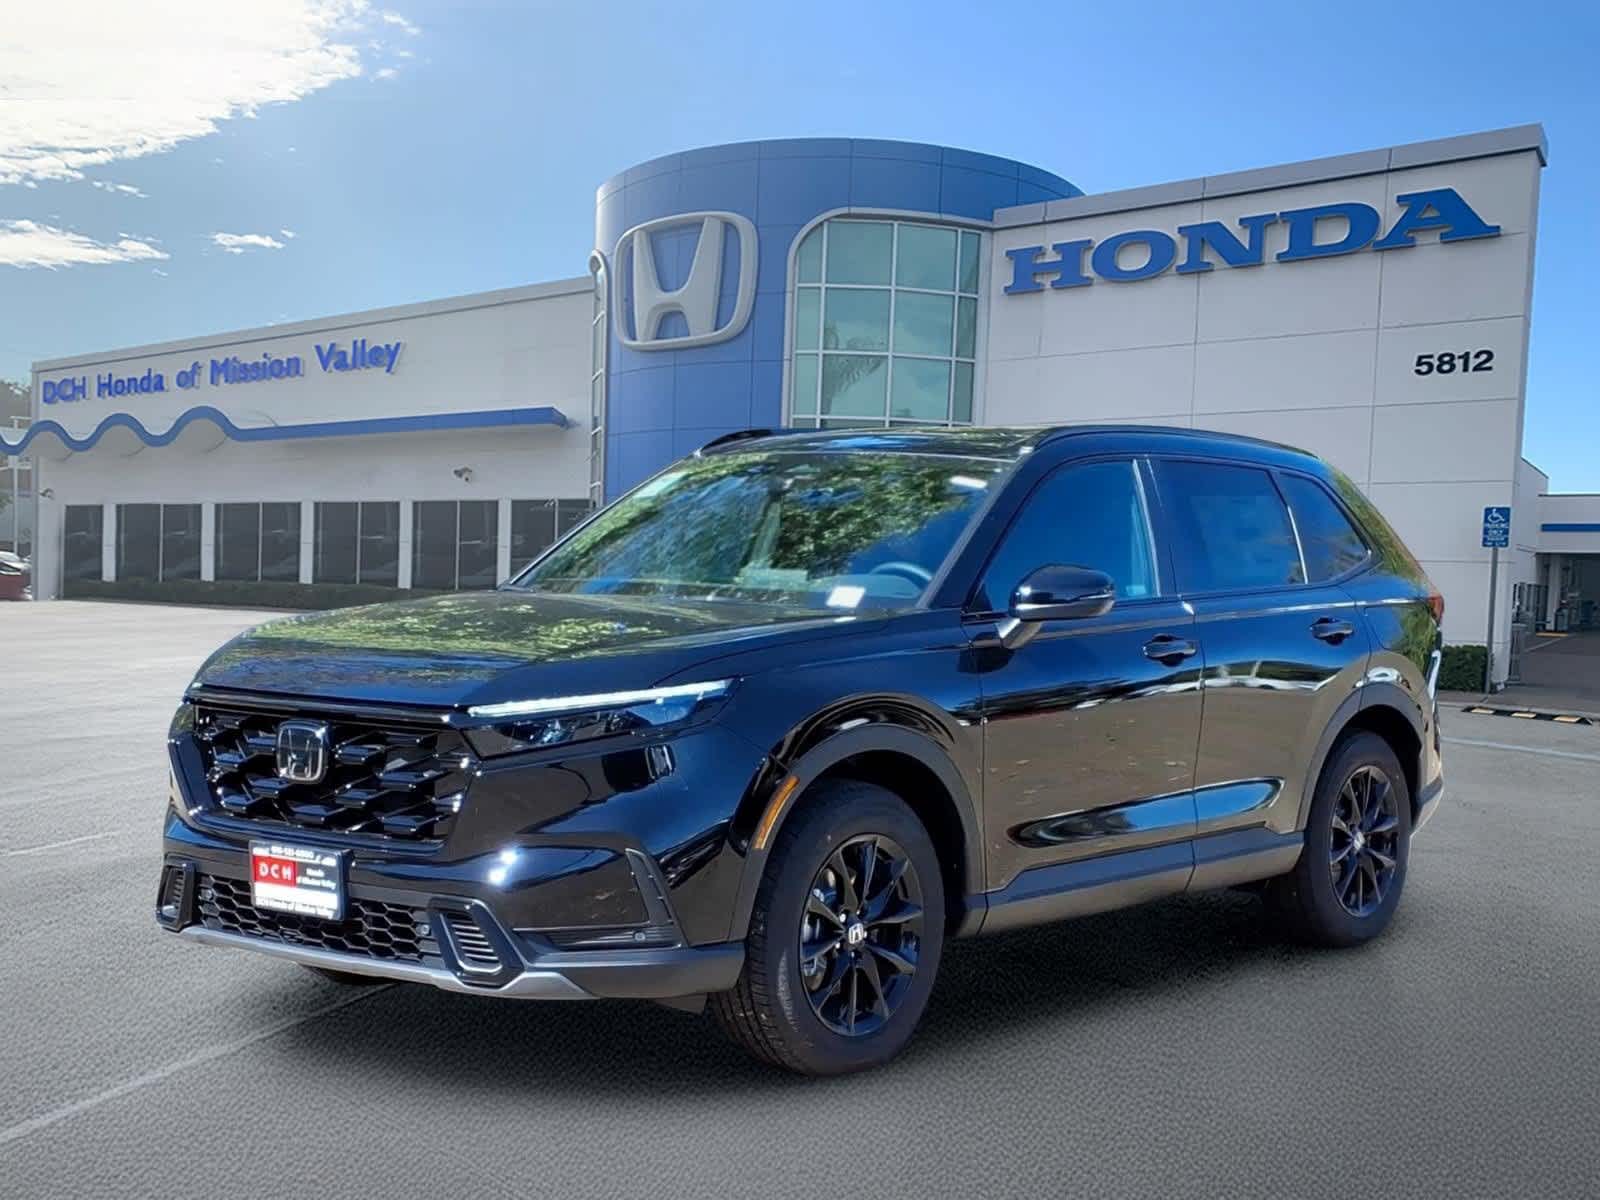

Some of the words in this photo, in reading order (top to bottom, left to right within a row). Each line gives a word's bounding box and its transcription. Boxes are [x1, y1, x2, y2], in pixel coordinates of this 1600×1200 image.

[1003, 187, 1502, 295] HONDA
[42, 376, 87, 404] DCH
[97, 368, 165, 398] Honda
[176, 361, 203, 388] of
[210, 352, 302, 385] Mission
[314, 338, 402, 374] Valley
[1414, 349, 1494, 376] 5812
[259, 861, 292, 881] DCH
